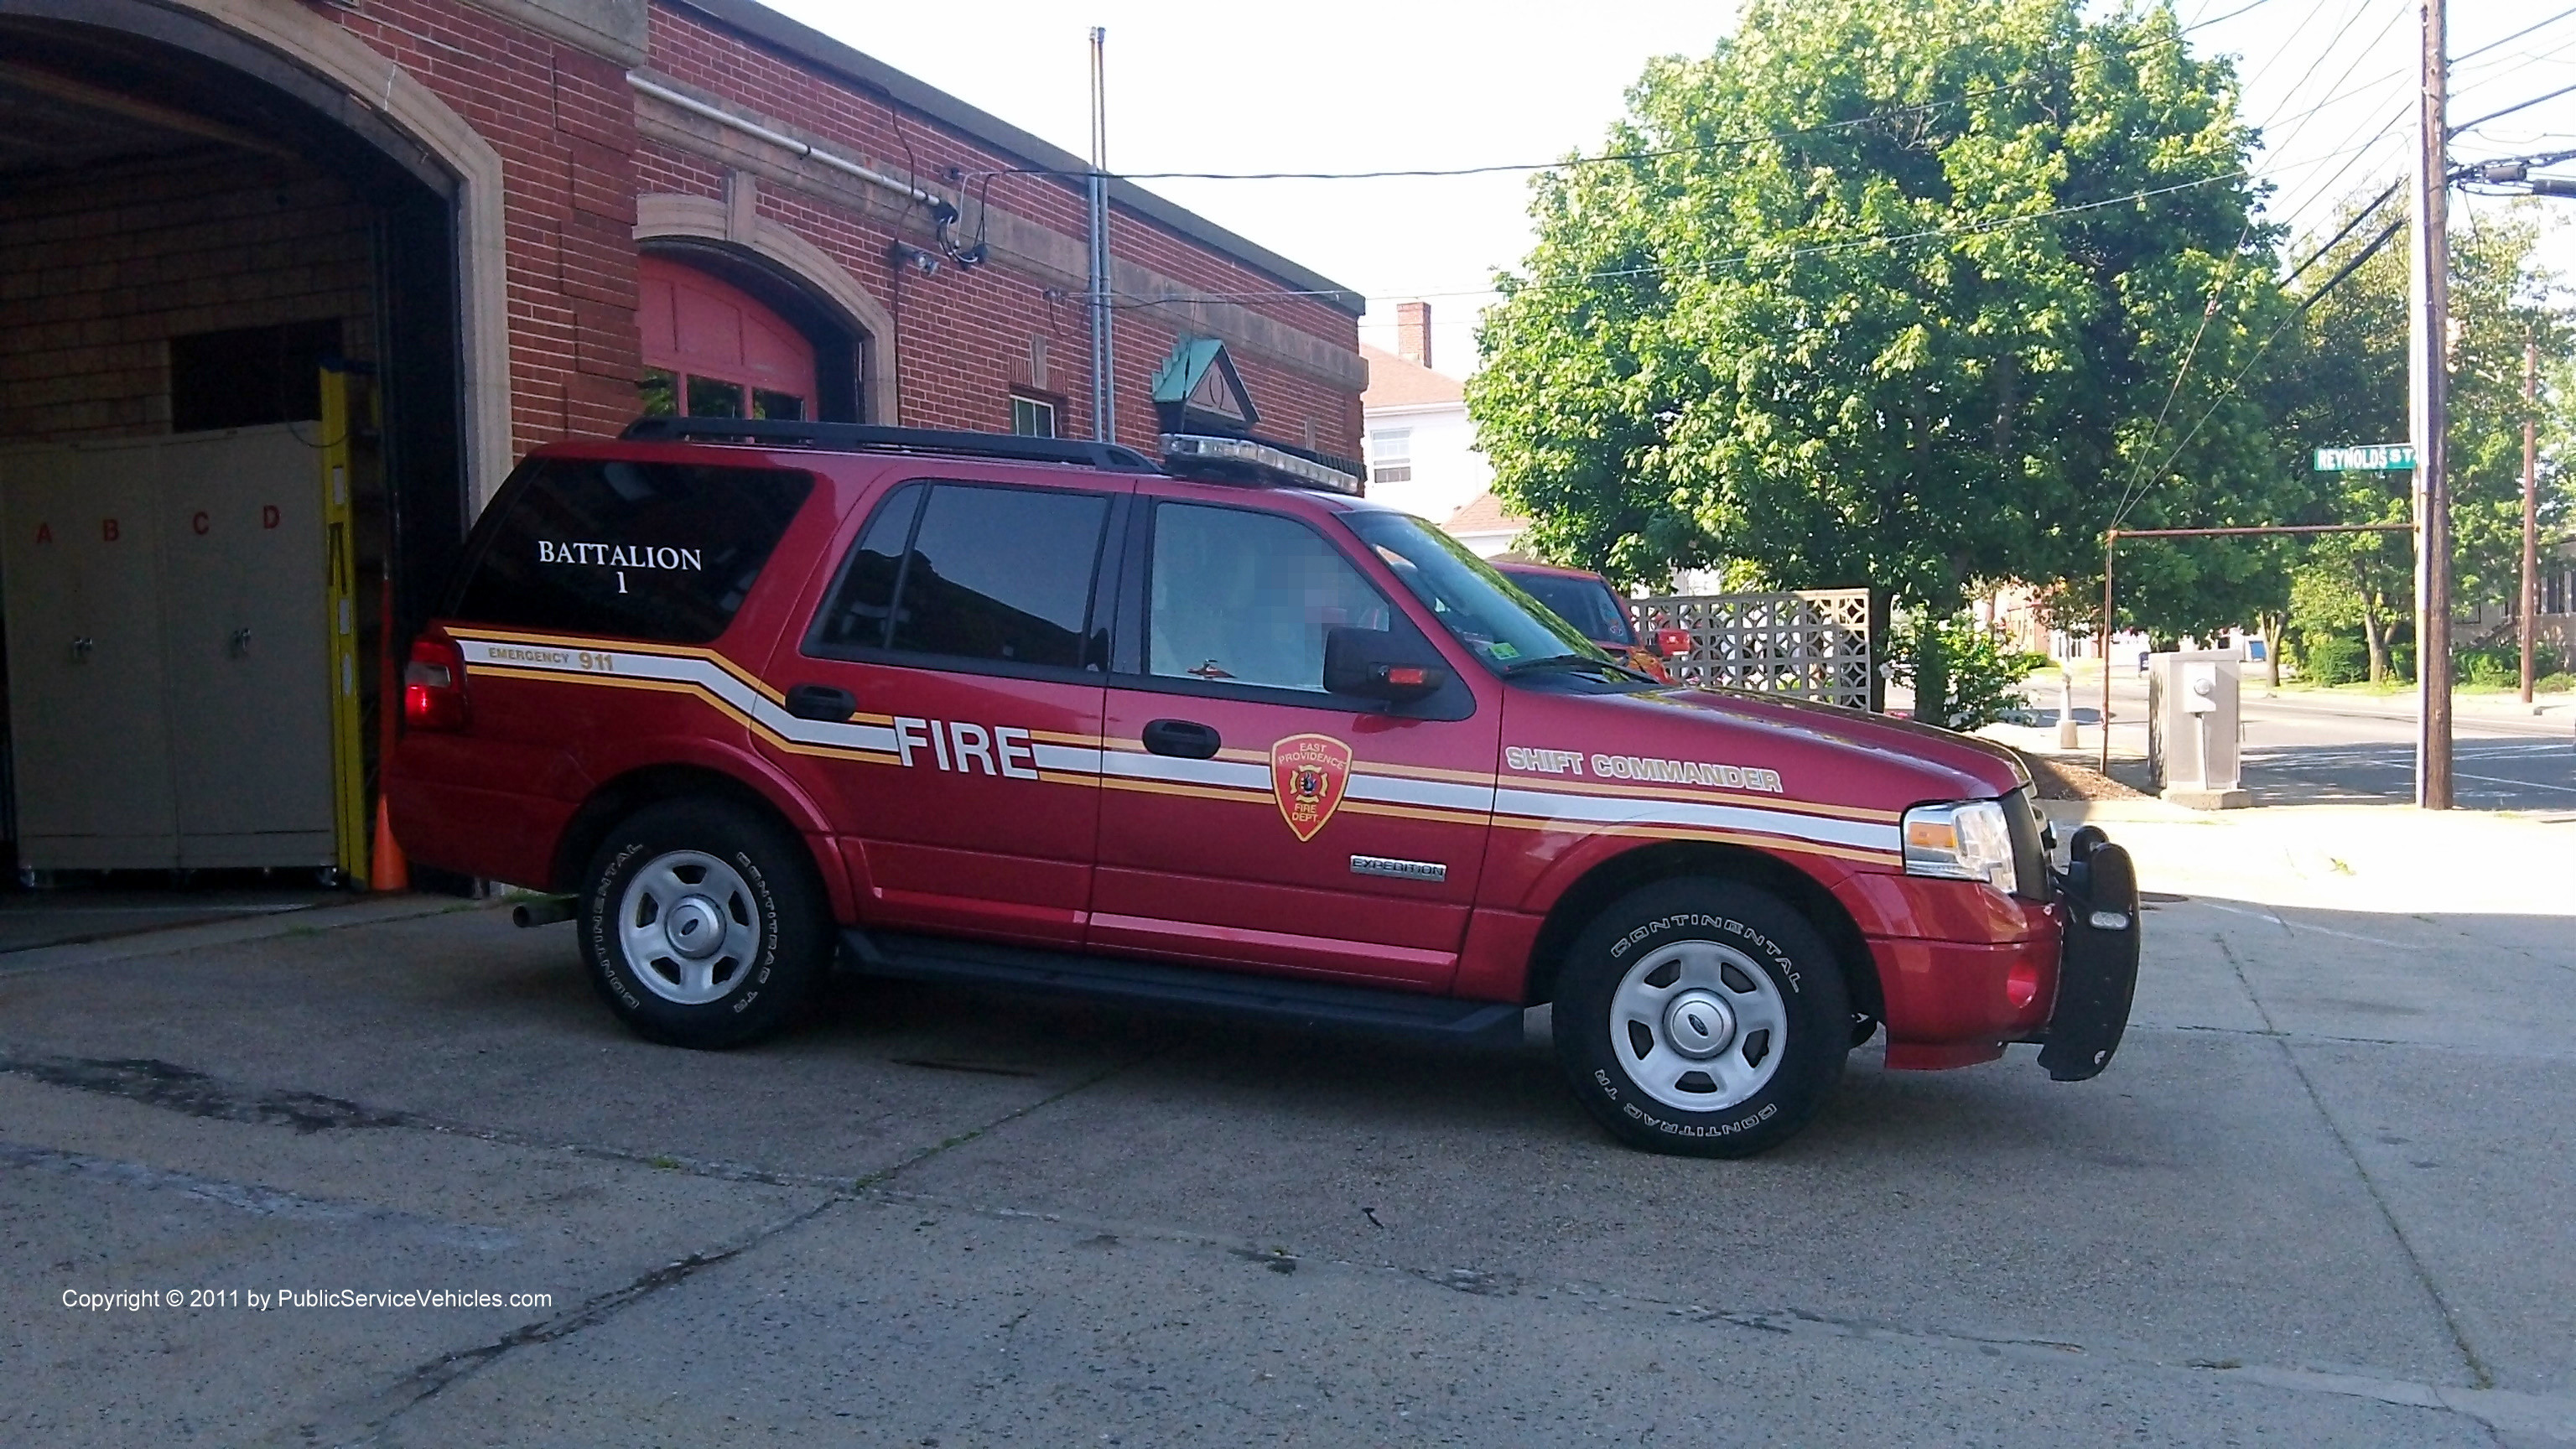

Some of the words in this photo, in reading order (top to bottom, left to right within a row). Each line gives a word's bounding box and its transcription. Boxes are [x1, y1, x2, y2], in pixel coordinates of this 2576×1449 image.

[2318, 448, 2387, 469] REYNOLDS
[193, 512, 210, 535] C
[263, 505, 281, 529] D
[36, 522, 53, 543] A
[102, 519, 119, 542] B
[538, 540, 703, 571] BATTALION
[615, 571, 628, 594] 1
[489, 647, 569, 664] EMERGENCY
[579, 652, 613, 672] 911
[894, 716, 1038, 780] FIRE
[1300, 743, 1327, 752] EAST
[1278, 751, 1347, 770] PROVIDENCE
[1506, 746, 1584, 775] SHIFT
[1592, 754, 1783, 792] COMMANDER
[1292, 813, 1321, 823] DEPT.
[1294, 803, 1317, 813] FIRE
[1352, 857, 1444, 877] EXPEDITION
[1611, 913, 1800, 993] CONTINENTAL
[1594, 1068, 1619, 1101] TR
[1623, 1102, 1778, 1137] CONTITRAC
